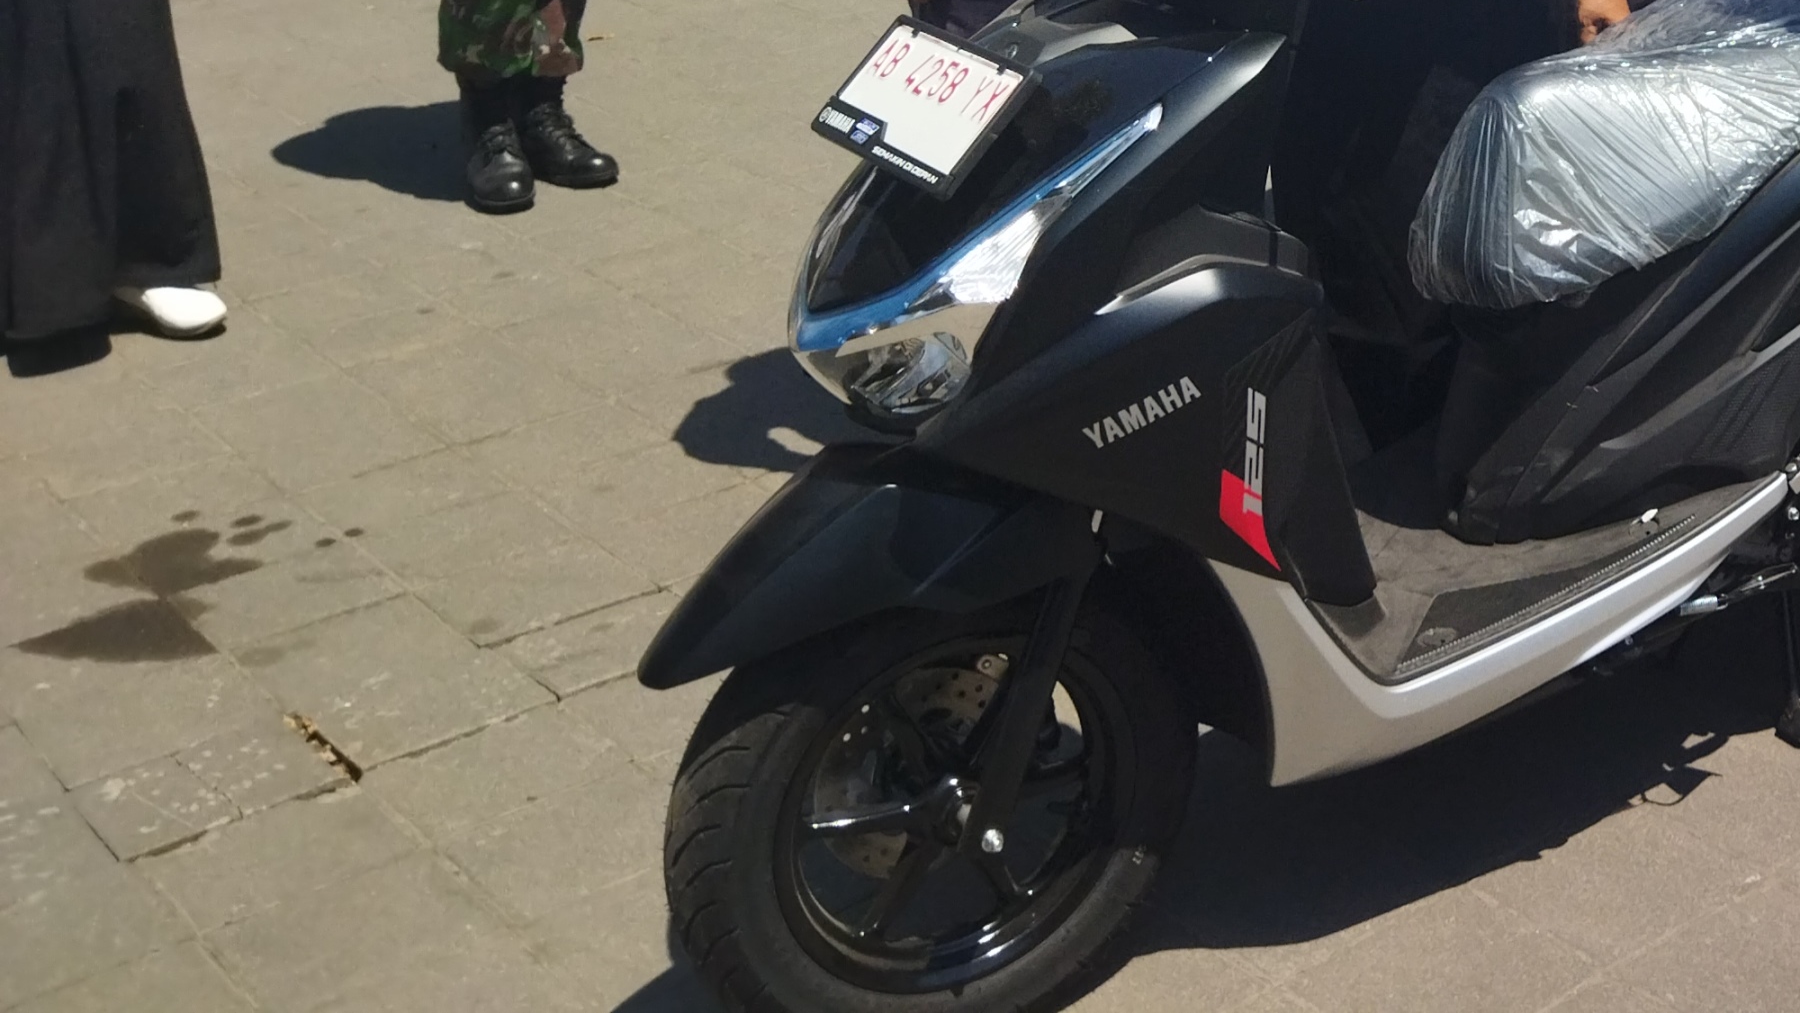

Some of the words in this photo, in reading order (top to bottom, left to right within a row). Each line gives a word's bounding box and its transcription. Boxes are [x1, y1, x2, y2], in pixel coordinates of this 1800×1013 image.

[867, 39, 911, 78] AB
[904, 54, 969, 104] 4258
[959, 75, 1010, 122] YX
[825, 107, 856, 134] YAMAHA
[871, 145, 905, 167] SEMAKIN
[1081, 375, 1202, 449] YAMAHA
[1242, 387, 1267, 517] 125
